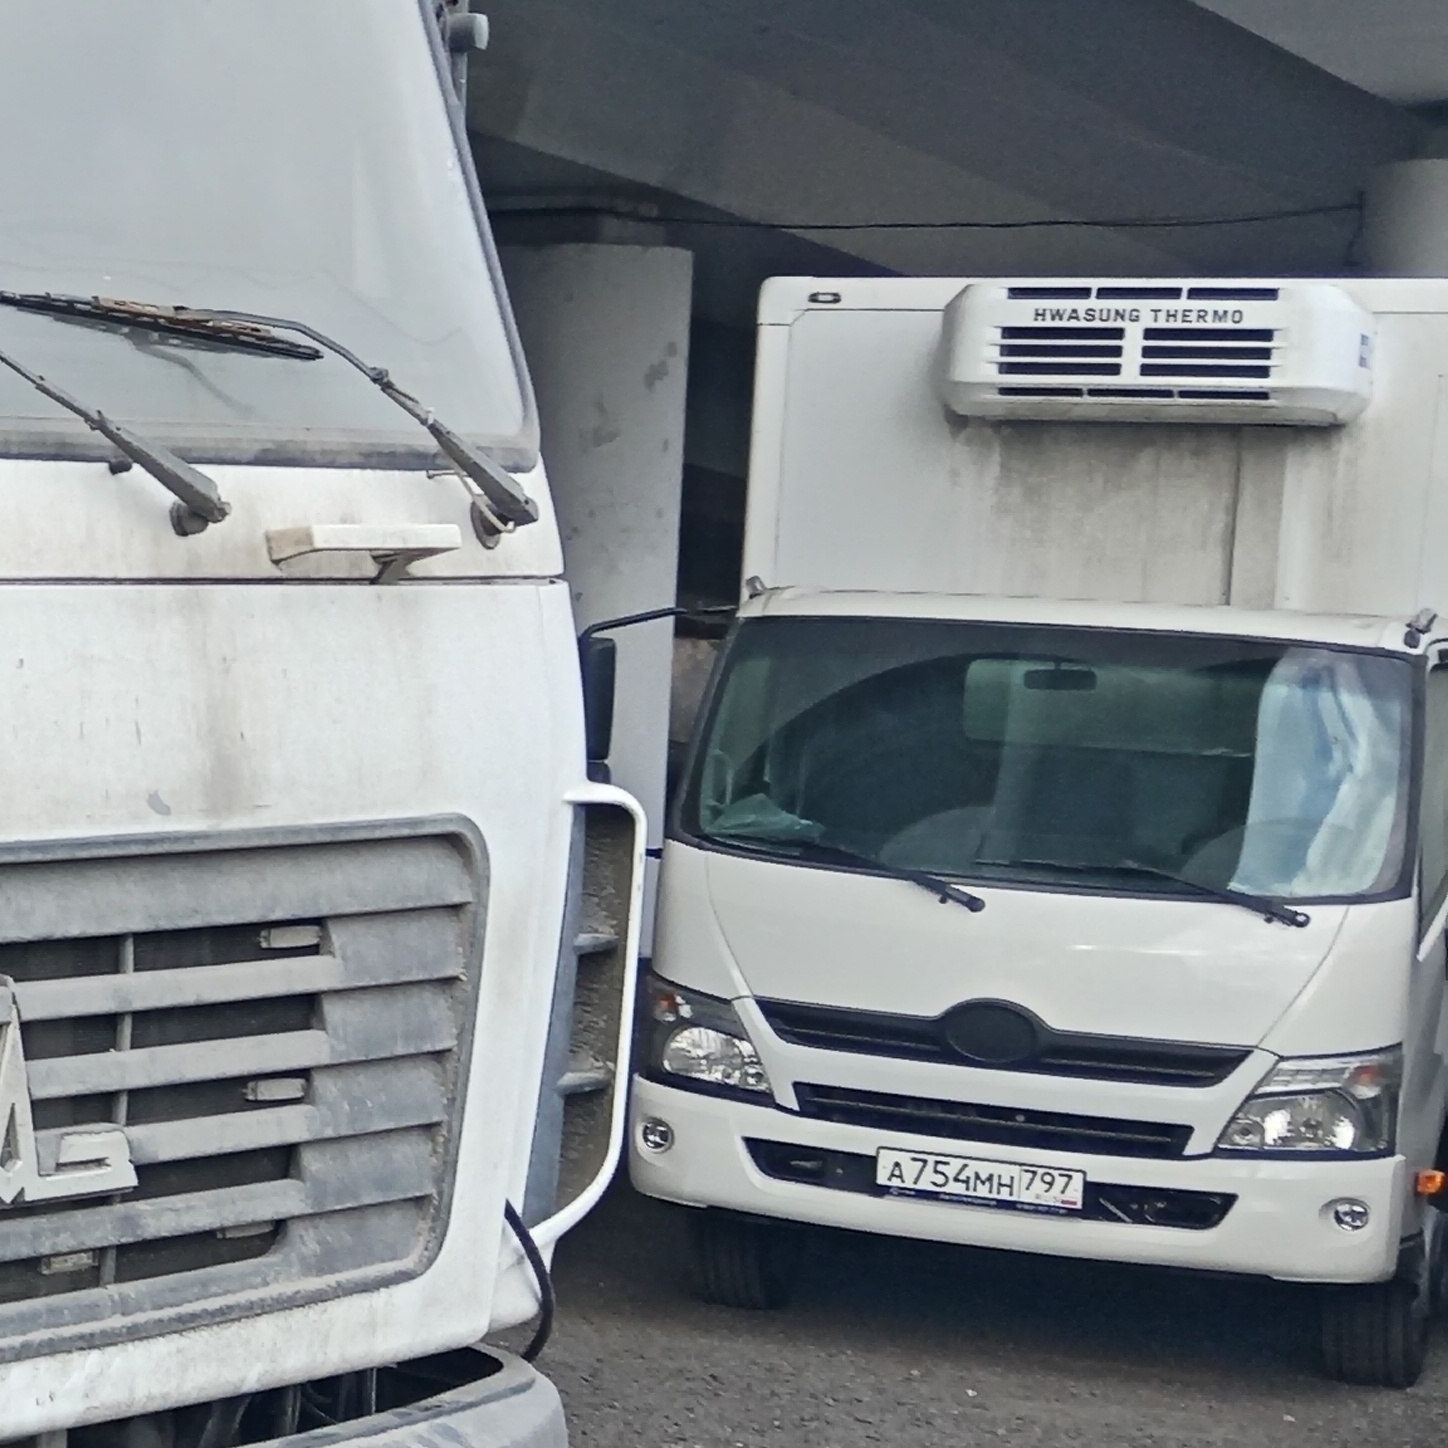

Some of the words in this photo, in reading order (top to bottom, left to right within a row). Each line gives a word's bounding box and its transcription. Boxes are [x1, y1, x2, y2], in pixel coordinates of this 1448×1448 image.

[1033, 307, 1141, 323] HWASUNG
[1150, 308, 1244, 324] THERMO
[1022, 1168, 1074, 1195] 797
